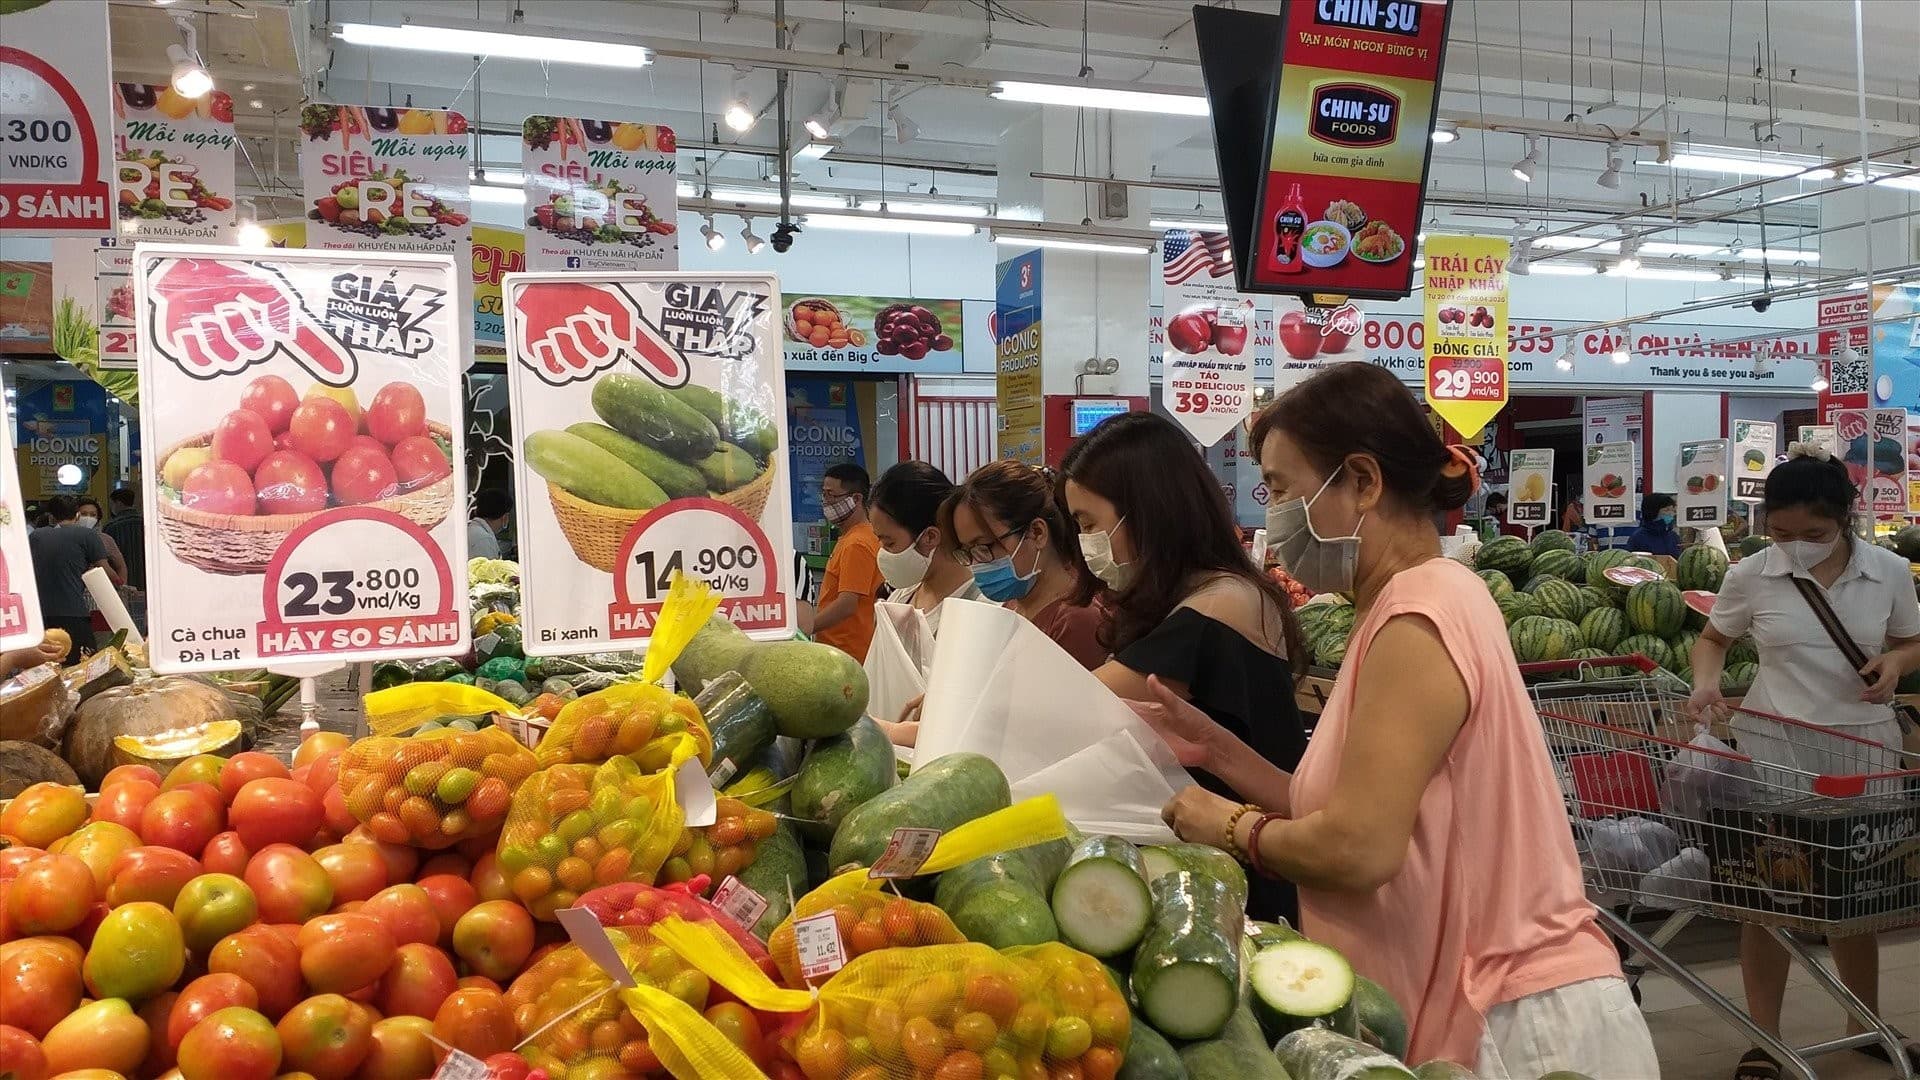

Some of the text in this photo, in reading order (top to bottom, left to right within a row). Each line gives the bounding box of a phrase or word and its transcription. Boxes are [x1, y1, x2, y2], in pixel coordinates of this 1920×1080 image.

[1300, 32, 1321, 47] VẠN
[1324, 35, 1350, 49] MÓN
[1353, 40, 1384, 53] NGON
[1320, 98, 1390, 122] CHIN-SU
[127, 121, 234, 150] Mỗi ngày
[1332, 122, 1376, 135] FOODS
[371, 138, 468, 161] Mỗi ngày
[9, 155, 68, 168] VND/KG
[588, 150, 676, 174] Mỗi ngày
[1351, 156, 1363, 167] gia
[17, 189, 104, 219] SÁNH
[1430, 253, 1504, 273] TRÁI CÂY
[1429, 275, 1464, 292] NHẬP
[331, 303, 398, 321] LUÔN LUÔN
[665, 310, 724, 326] LUÔN LUÔN
[1001, 329, 1038, 355] ICONIC
[1433, 338, 1499, 356] ĐỒNG GIÁ!
[792, 349, 817, 361] xuất
[821, 349, 844, 361] đến
[848, 351, 867, 364] Big
[871, 352, 880, 362] C
[1001, 353, 1039, 373] PRODUCTS
[1178, 361, 1197, 369] NHẬP
[1198, 359, 1216, 369] KHẨU
[1200, 371, 1219, 380] TÁO
[1650, 366, 1681, 377] Thank
[1682, 369, 1700, 378] you
[1702, 368, 1709, 377] &
[1711, 370, 1727, 378] see
[1730, 370, 1747, 379] you
[1172, 381, 1245, 392] RED DELICIOUS
[1472, 386, 1500, 397] vnd/kg
[31, 437, 99, 453] ICONIC
[789, 445, 856, 456] PRODUCTS
[31, 455, 100, 466] PRODUCTS
[1516, 506, 1529, 518] 51
[357, 592, 421, 610] vnd/Kg
[171, 627, 246, 643] Cà chua
[263, 621, 458, 653] HÃY SO SÁNH
[541, 626, 598, 642] Bí xanh
[179, 648, 205, 663] Đà
